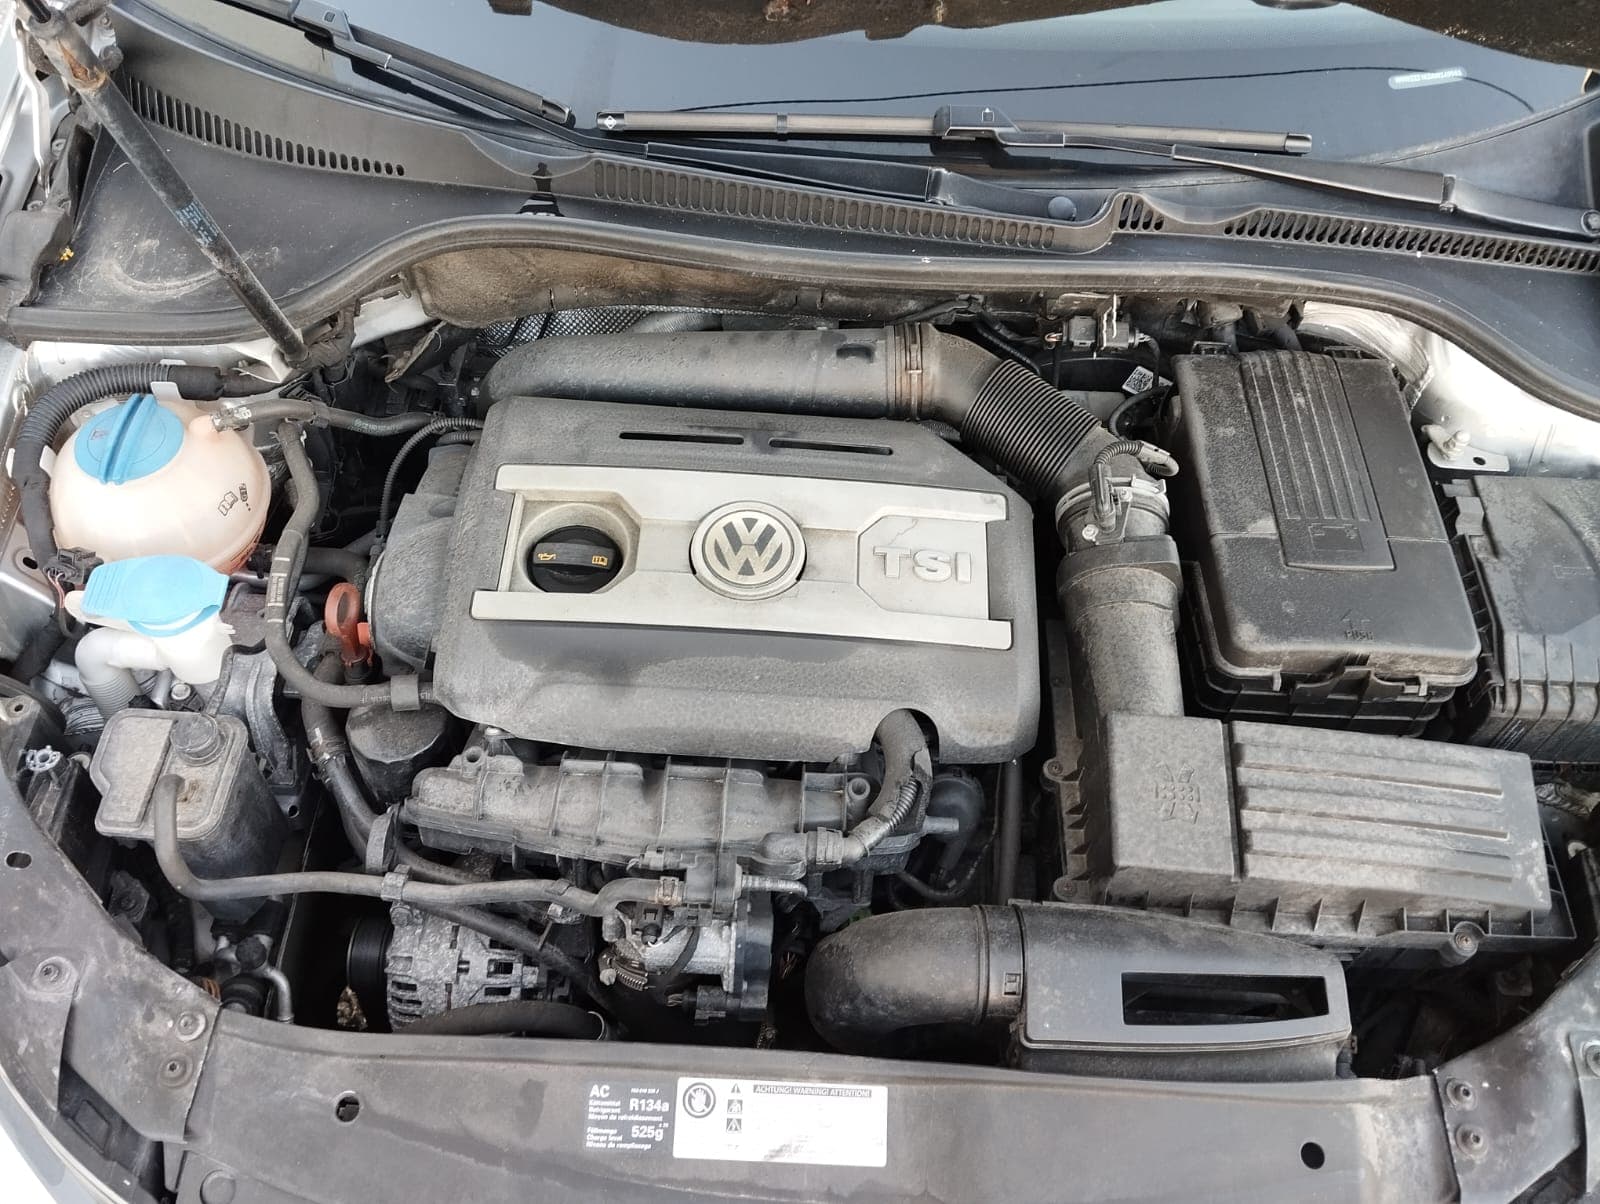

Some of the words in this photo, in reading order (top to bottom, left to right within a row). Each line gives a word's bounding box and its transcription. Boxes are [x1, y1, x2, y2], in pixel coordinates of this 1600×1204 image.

[873, 545, 971, 583] TSI
[589, 1084, 610, 1098] AC
[755, 1085, 792, 1095] ACHTUNG!
[792, 1086, 829, 1096] WARNING!
[830, 1088, 871, 1098] ATTENTION!
[629, 1098, 670, 1112] R134a
[631, 1125, 664, 1141] 525g
